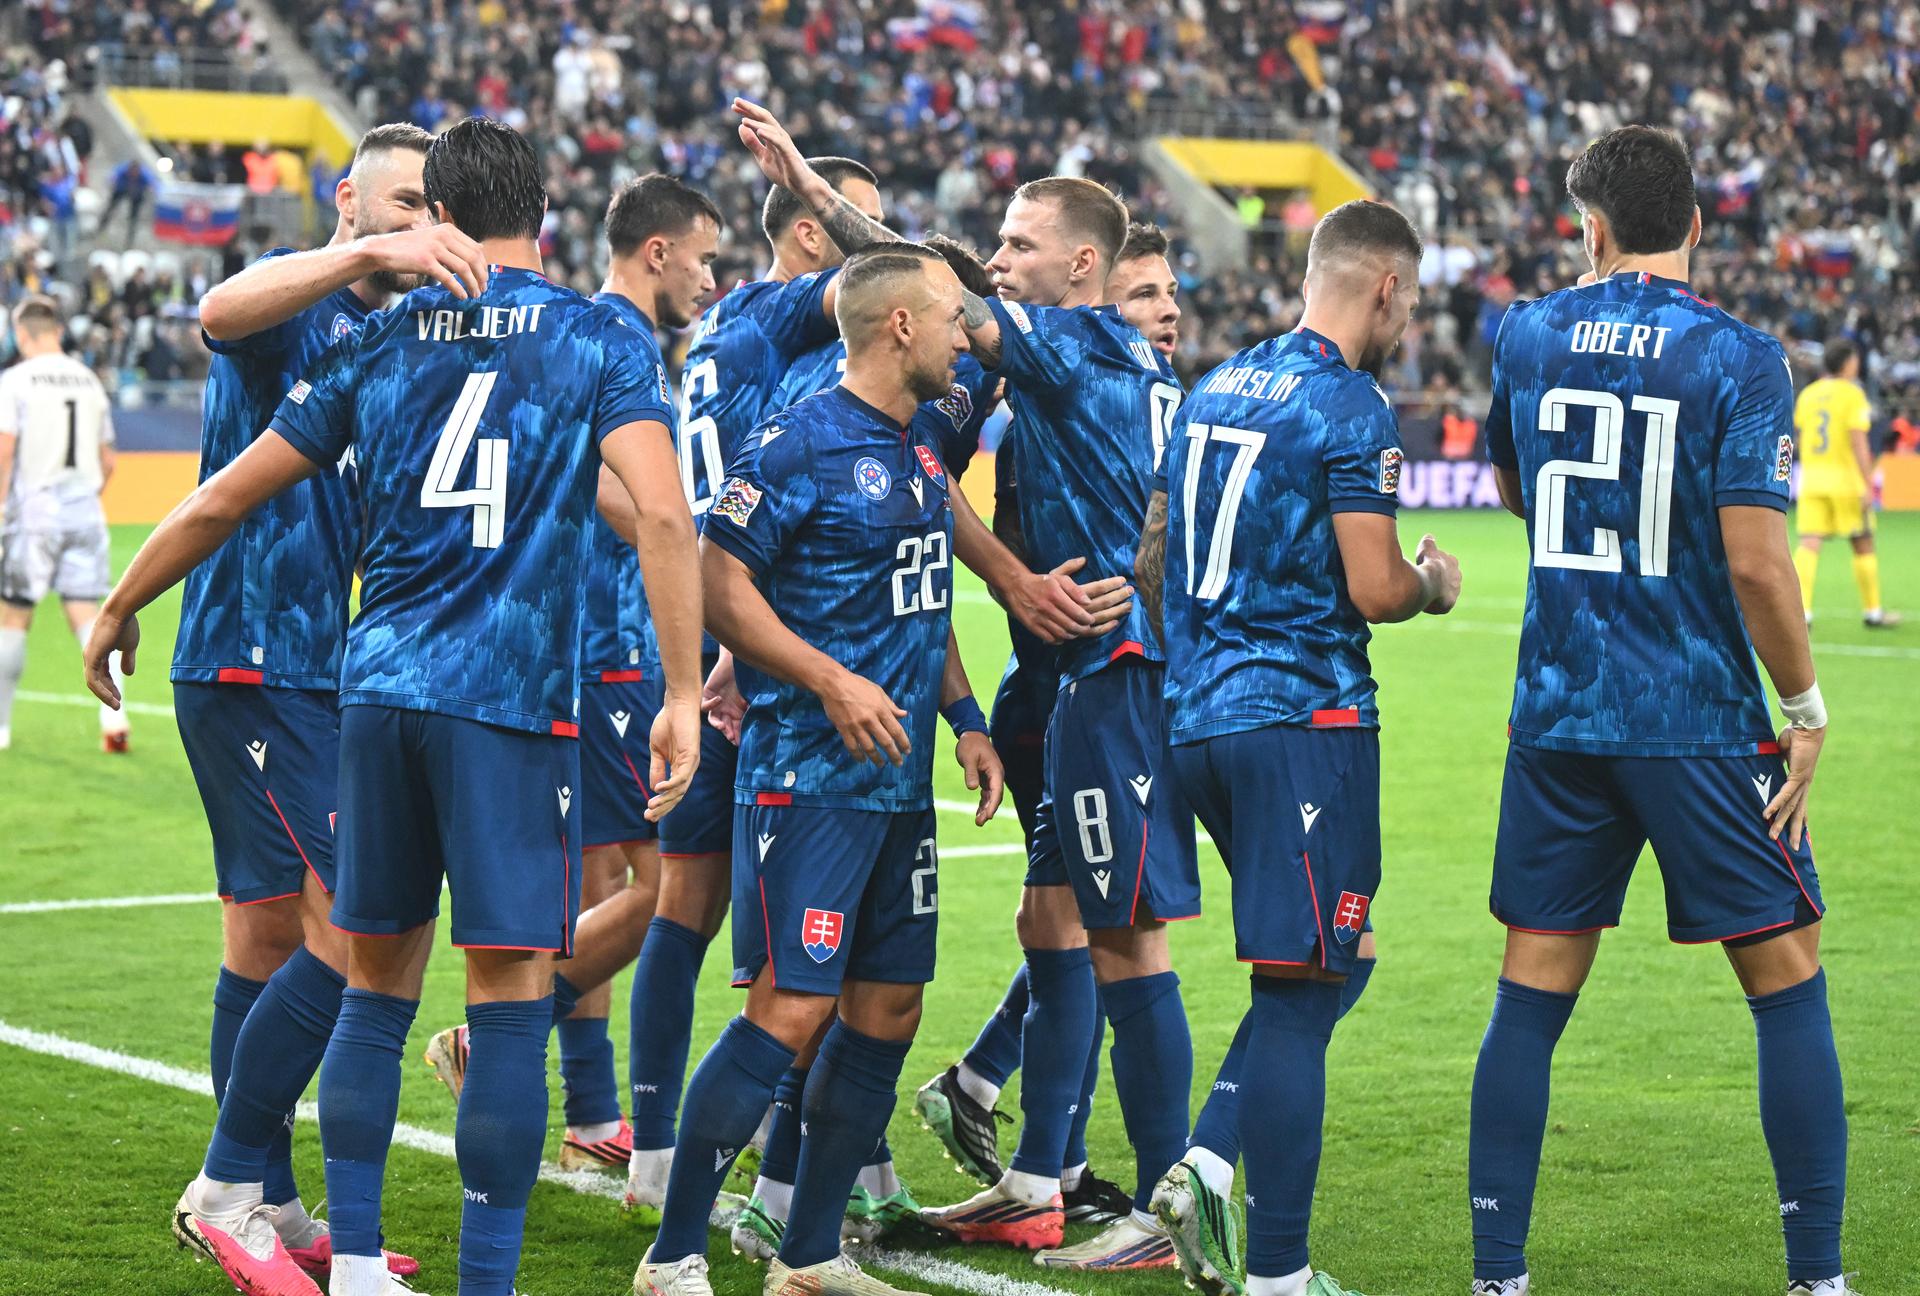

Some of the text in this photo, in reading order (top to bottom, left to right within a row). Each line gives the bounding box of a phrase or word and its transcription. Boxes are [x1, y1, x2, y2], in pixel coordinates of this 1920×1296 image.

[417, 304, 547, 341] VALJENT
[1570, 320, 1672, 359] OBERT
[63, 398, 77, 469] 1
[1813, 410, 1831, 456] 3
[420, 370, 509, 549] 4
[1533, 387, 1681, 578] 21
[1399, 461, 1501, 508] UEFA
[1183, 422, 1267, 601] 17
[892, 530, 948, 616] 22
[1073, 788, 1113, 864] 8
[1213, 1081, 1239, 1093] SVK
[463, 1187, 488, 1204] SVK
[1472, 1196, 1499, 1211] SVK
